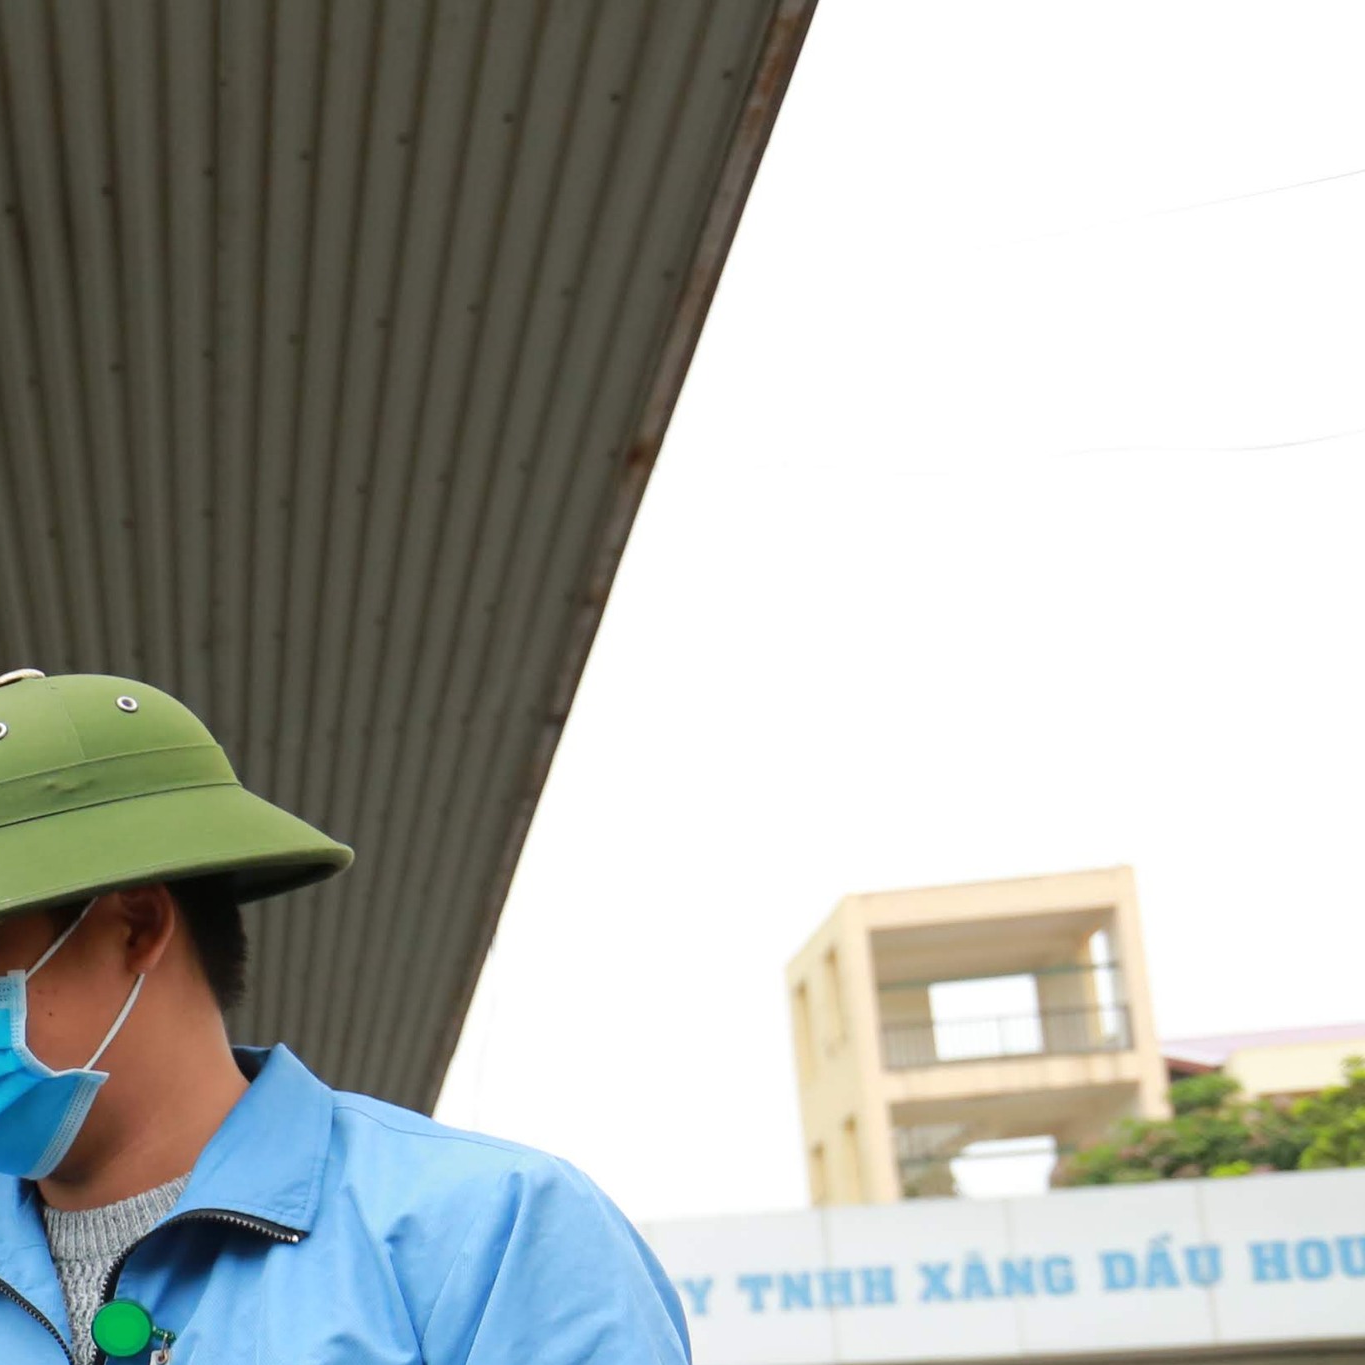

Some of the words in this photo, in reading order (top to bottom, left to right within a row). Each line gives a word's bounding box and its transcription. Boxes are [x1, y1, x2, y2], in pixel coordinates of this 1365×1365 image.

[736, 1265, 897, 1313] TNHH
[916, 1246, 1077, 1303] XĂNG
[1247, 1233, 1365, 1283] HOU
